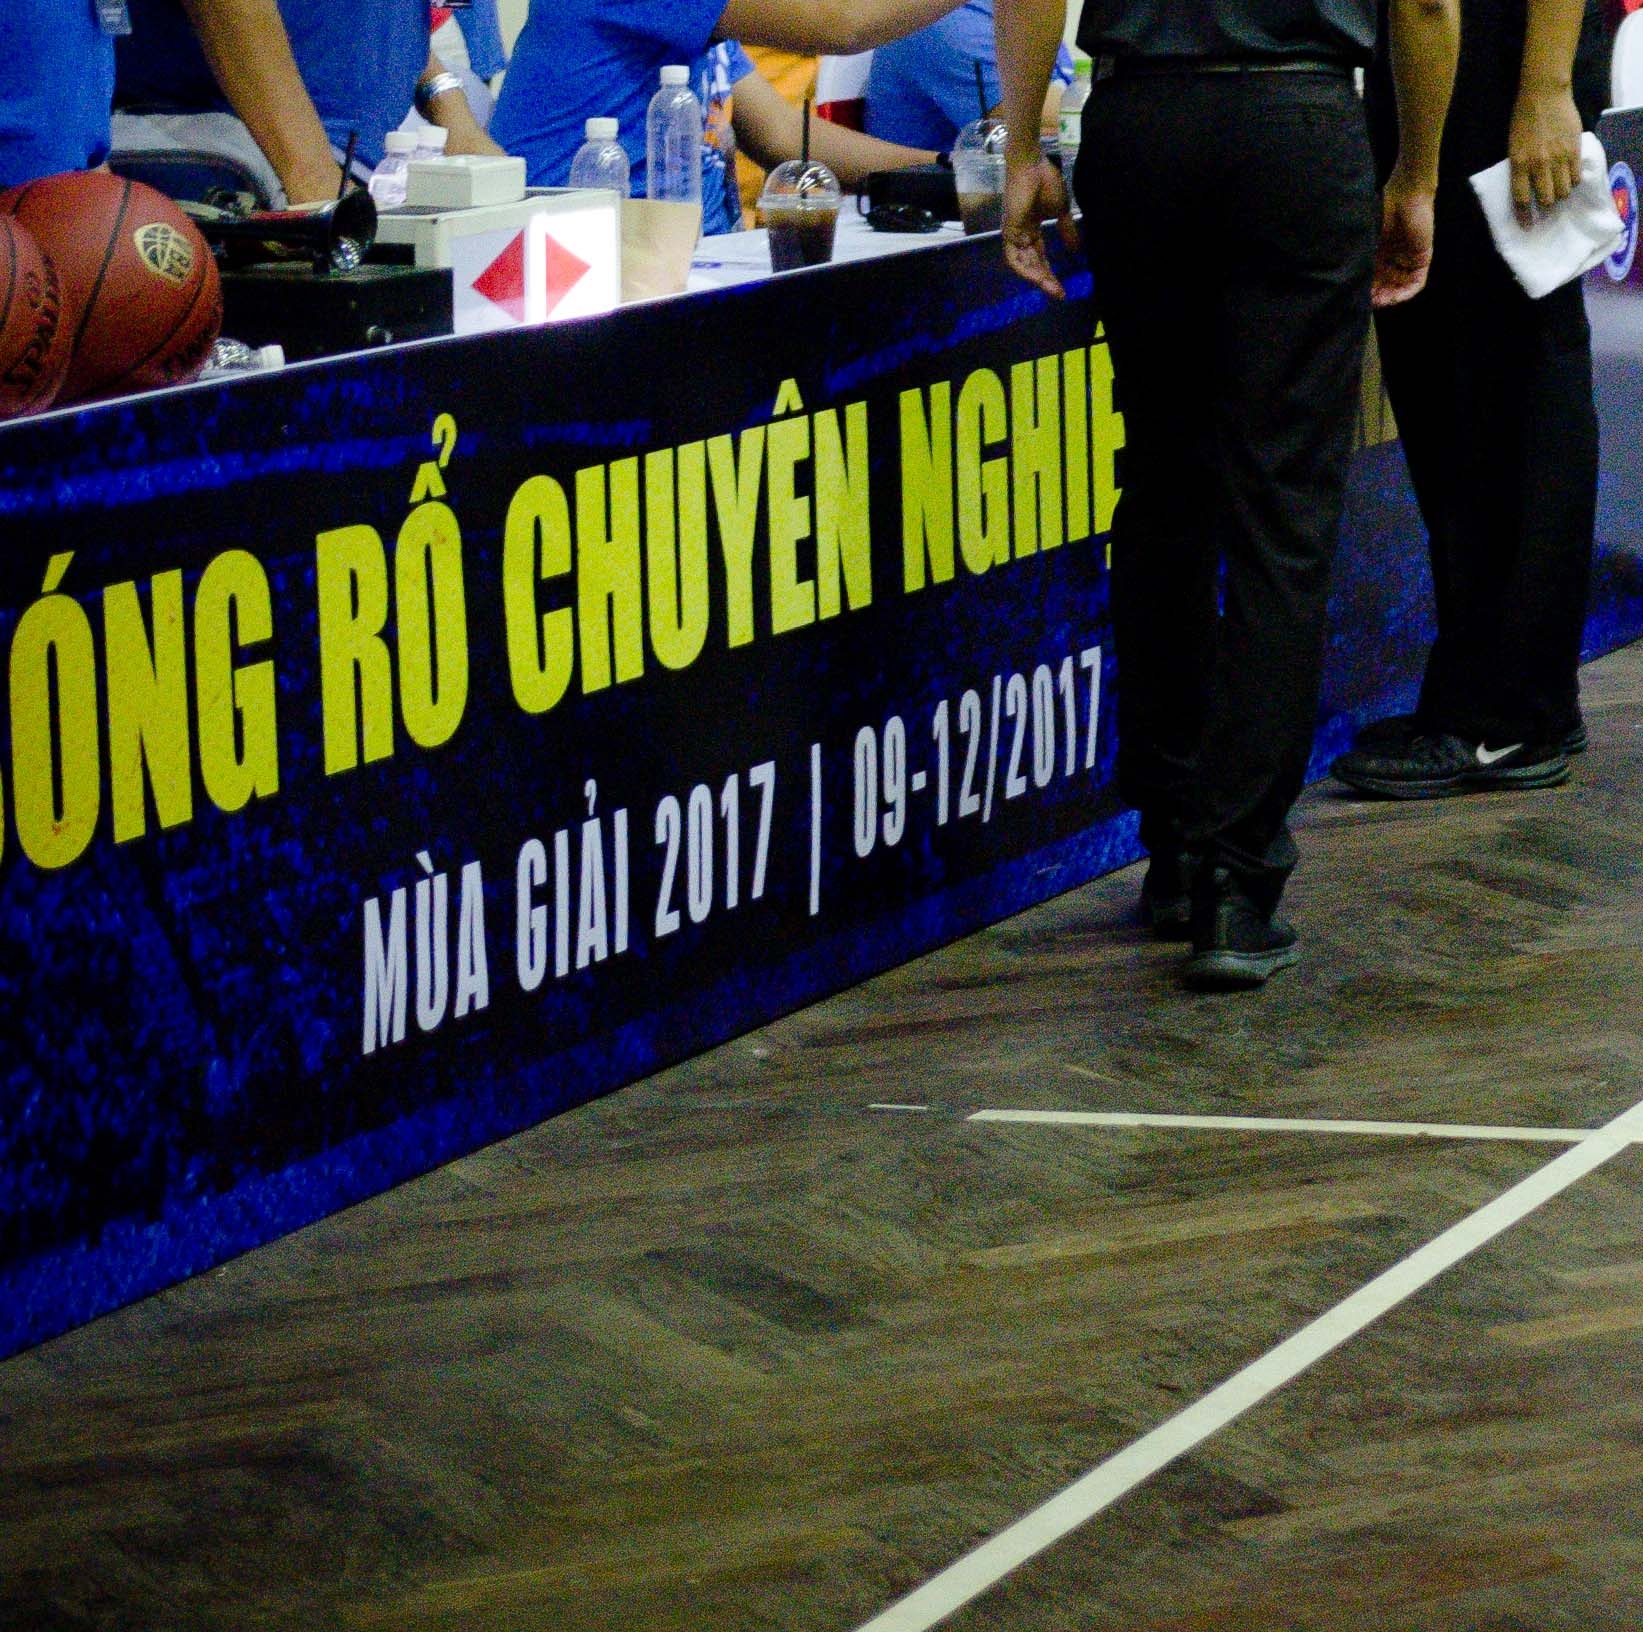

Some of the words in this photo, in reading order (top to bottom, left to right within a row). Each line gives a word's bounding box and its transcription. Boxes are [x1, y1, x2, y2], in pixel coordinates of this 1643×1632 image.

[0, 551, 281, 871] ÓNG
[315, 413, 470, 779] RỔ
[503, 378, 873, 714] CHUYÊN
[361, 850, 491, 1054] MÙA
[515, 779, 630, 992] GIẢI
[653, 761, 779, 938] 2017
[852, 645, 1105, 859] 09-12/2017
